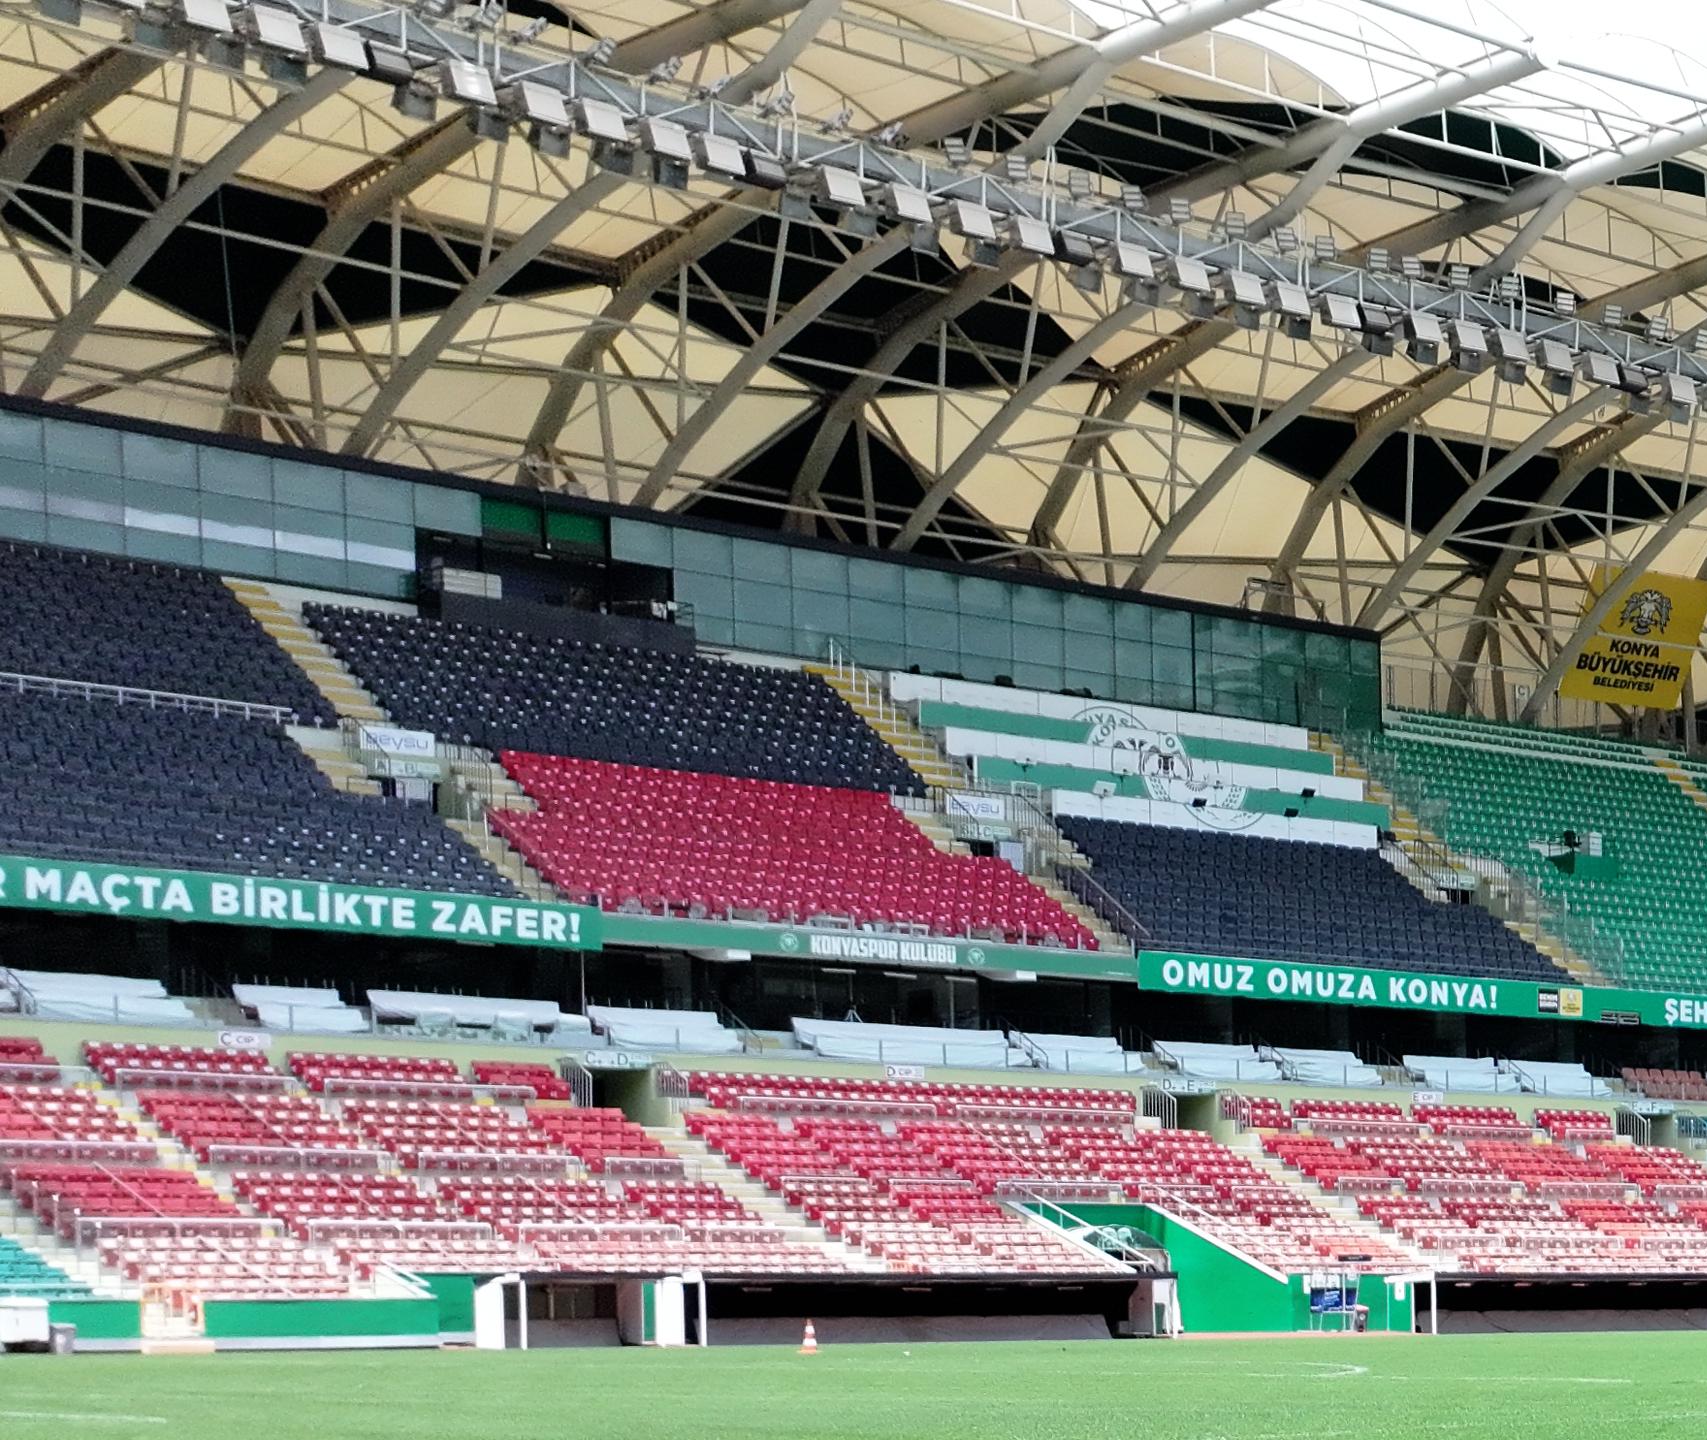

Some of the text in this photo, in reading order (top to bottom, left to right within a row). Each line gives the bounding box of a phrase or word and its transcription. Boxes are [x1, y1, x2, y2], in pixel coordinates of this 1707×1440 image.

[1609, 639, 1660, 659] KONYA
[1576, 652, 1680, 682] BÜYÜKŞEHİR
[1593, 675, 1654, 692] BELEDİYESİ
[25, 866, 194, 914] MAÇTA
[210, 878, 416, 930] BİRLİKTE
[431, 900, 581, 943] ZAFER!
[810, 935, 898, 960] KONYASPOR
[1162, 959, 1499, 1009] OMUZ OMUZA KONYA!
[220, 1032, 231, 1046] C
[617, 1054, 628, 1065] D
[1163, 1079, 1171, 1090] D
